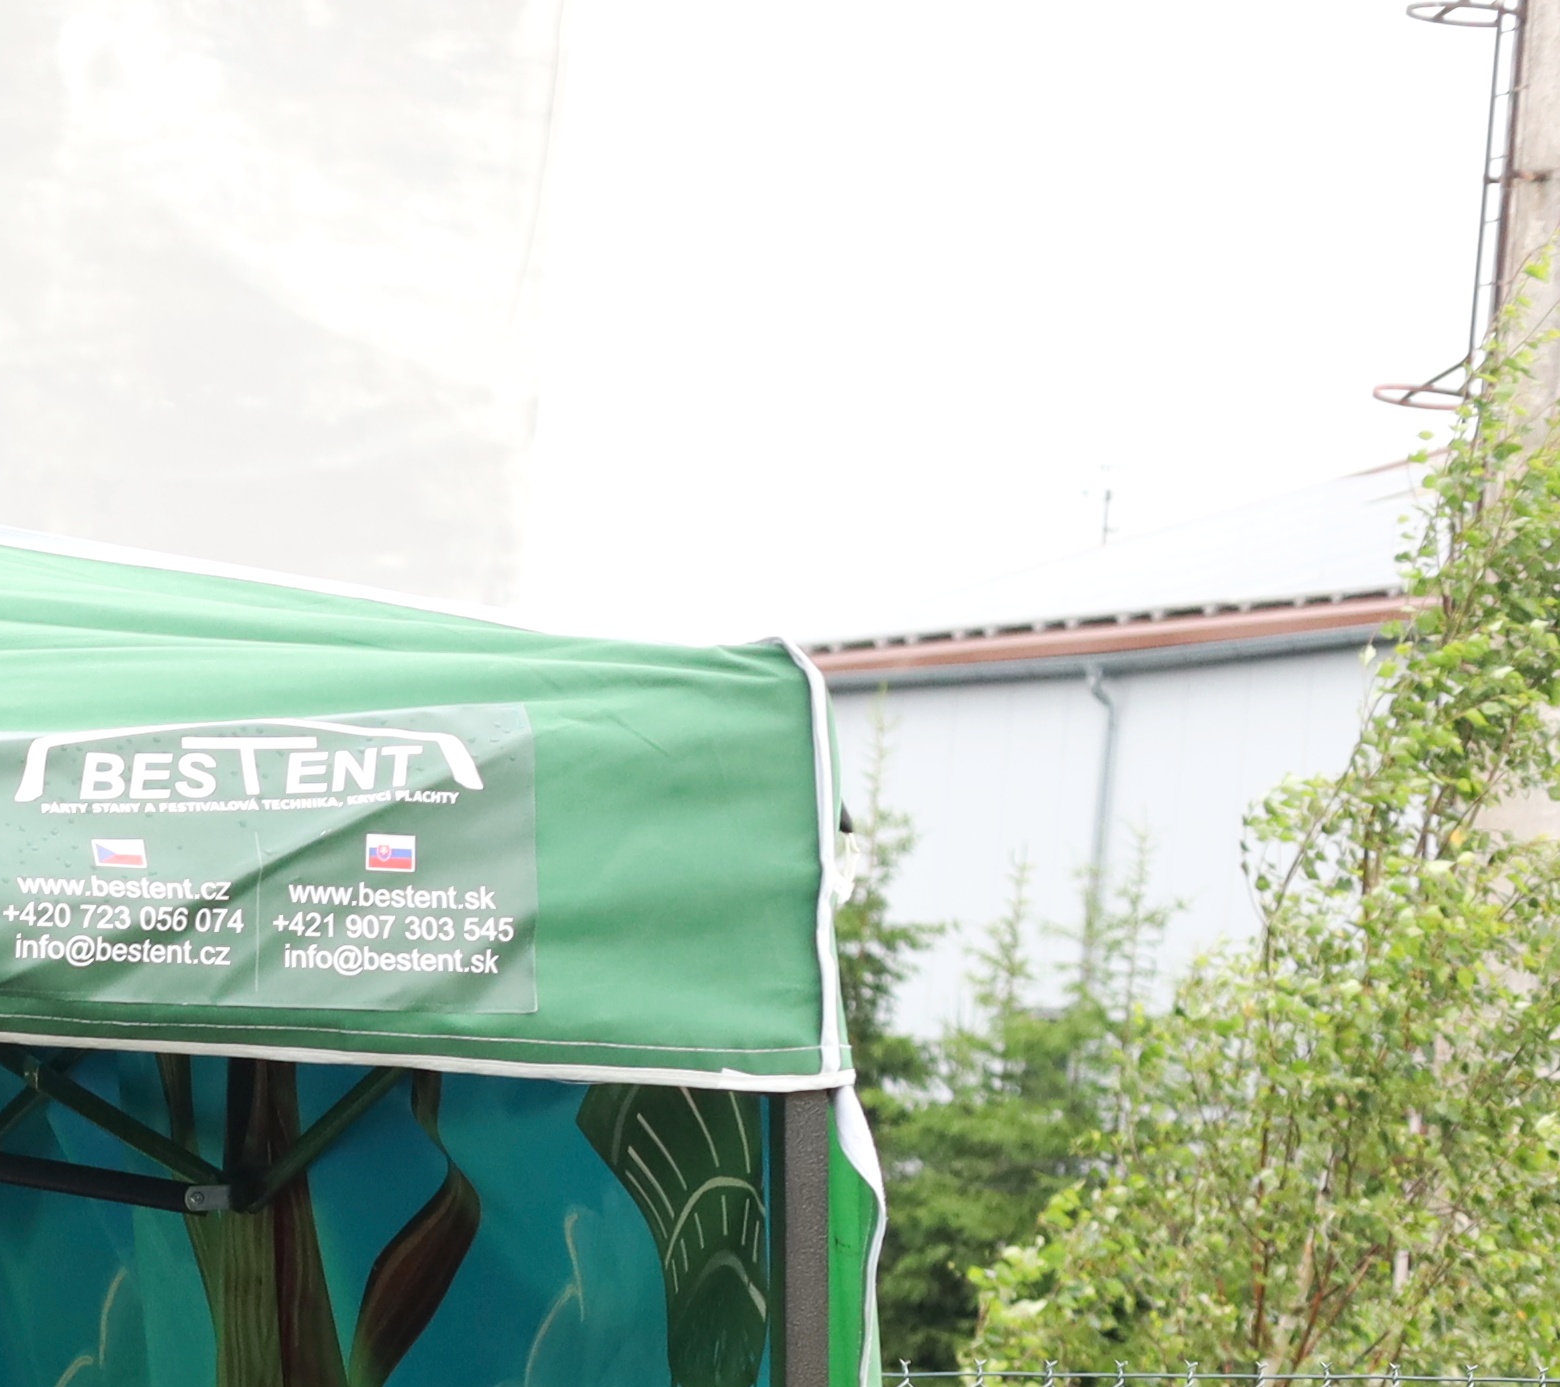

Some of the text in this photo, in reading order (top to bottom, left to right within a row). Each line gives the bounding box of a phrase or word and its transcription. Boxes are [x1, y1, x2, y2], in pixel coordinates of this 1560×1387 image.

[79, 736, 423, 800] BESTENT
[92, 802, 140, 814] STANY
[144, 802, 156, 813] A
[159, 799, 259, 813] FESTIVALOVÁ
[261, 797, 344, 811] TECHNIKA,
[394, 789, 459, 805] PLACHTY
[16, 875, 232, 900] www.bestent.cz
[288, 881, 497, 910] www.bestent.sk
[2, 902, 245, 934] +420 723 056 074
[272, 911, 515, 942] +421 907 303 545
[14, 933, 231, 967] info@bestent.cz
[284, 943, 500, 976] info@bestent.sk
